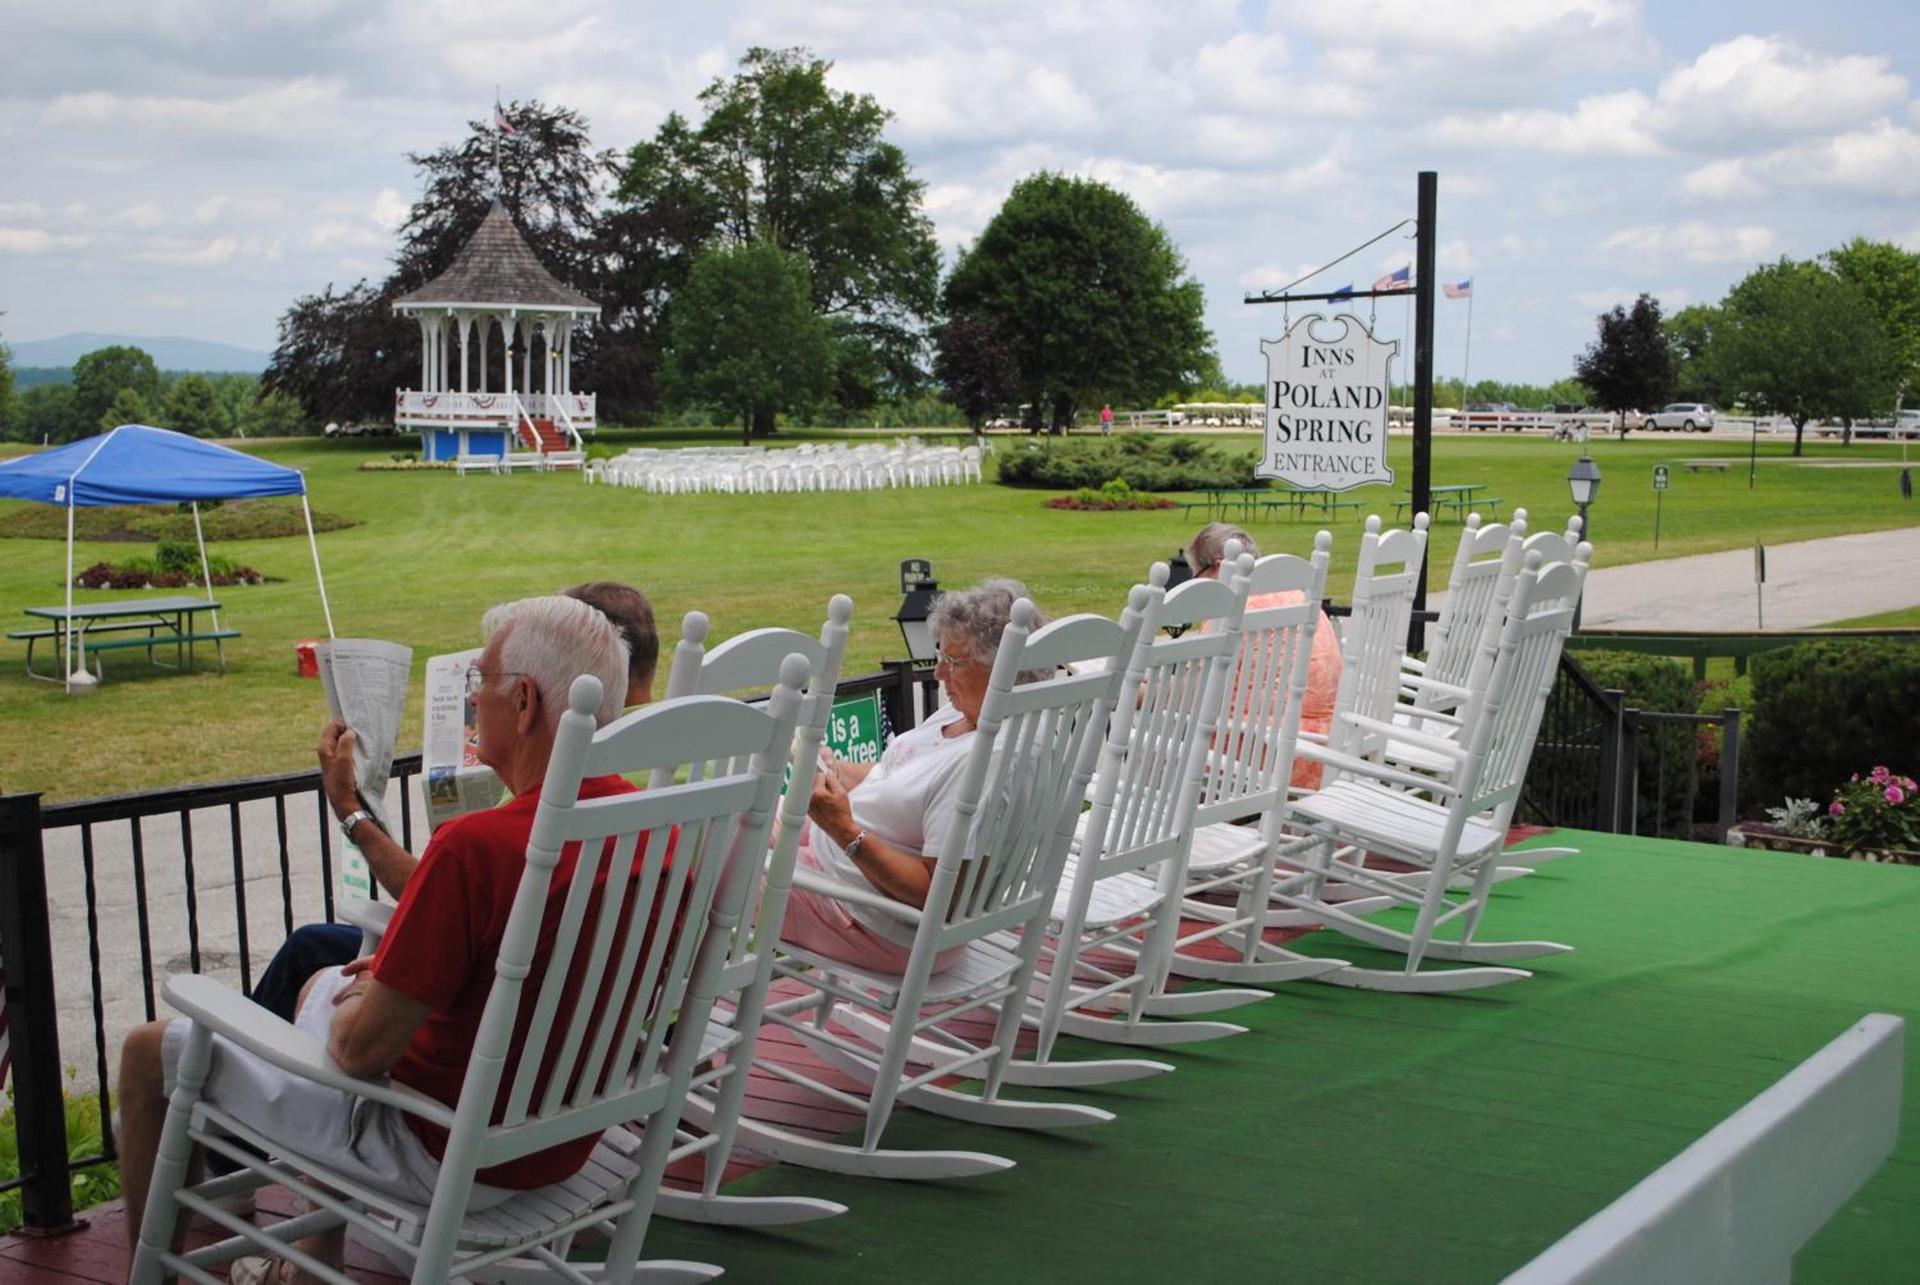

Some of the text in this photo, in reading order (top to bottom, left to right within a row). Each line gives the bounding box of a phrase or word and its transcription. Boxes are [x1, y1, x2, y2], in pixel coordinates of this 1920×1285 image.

[1301, 345, 1355, 368] INNS
[1319, 369, 1336, 379] AT
[1272, 380, 1383, 410] POLAND
[1276, 413, 1373, 444] SPRING
[1273, 452, 1376, 475] ENTRANCE
[831, 712, 847, 743] is
[849, 714, 860, 739] a
